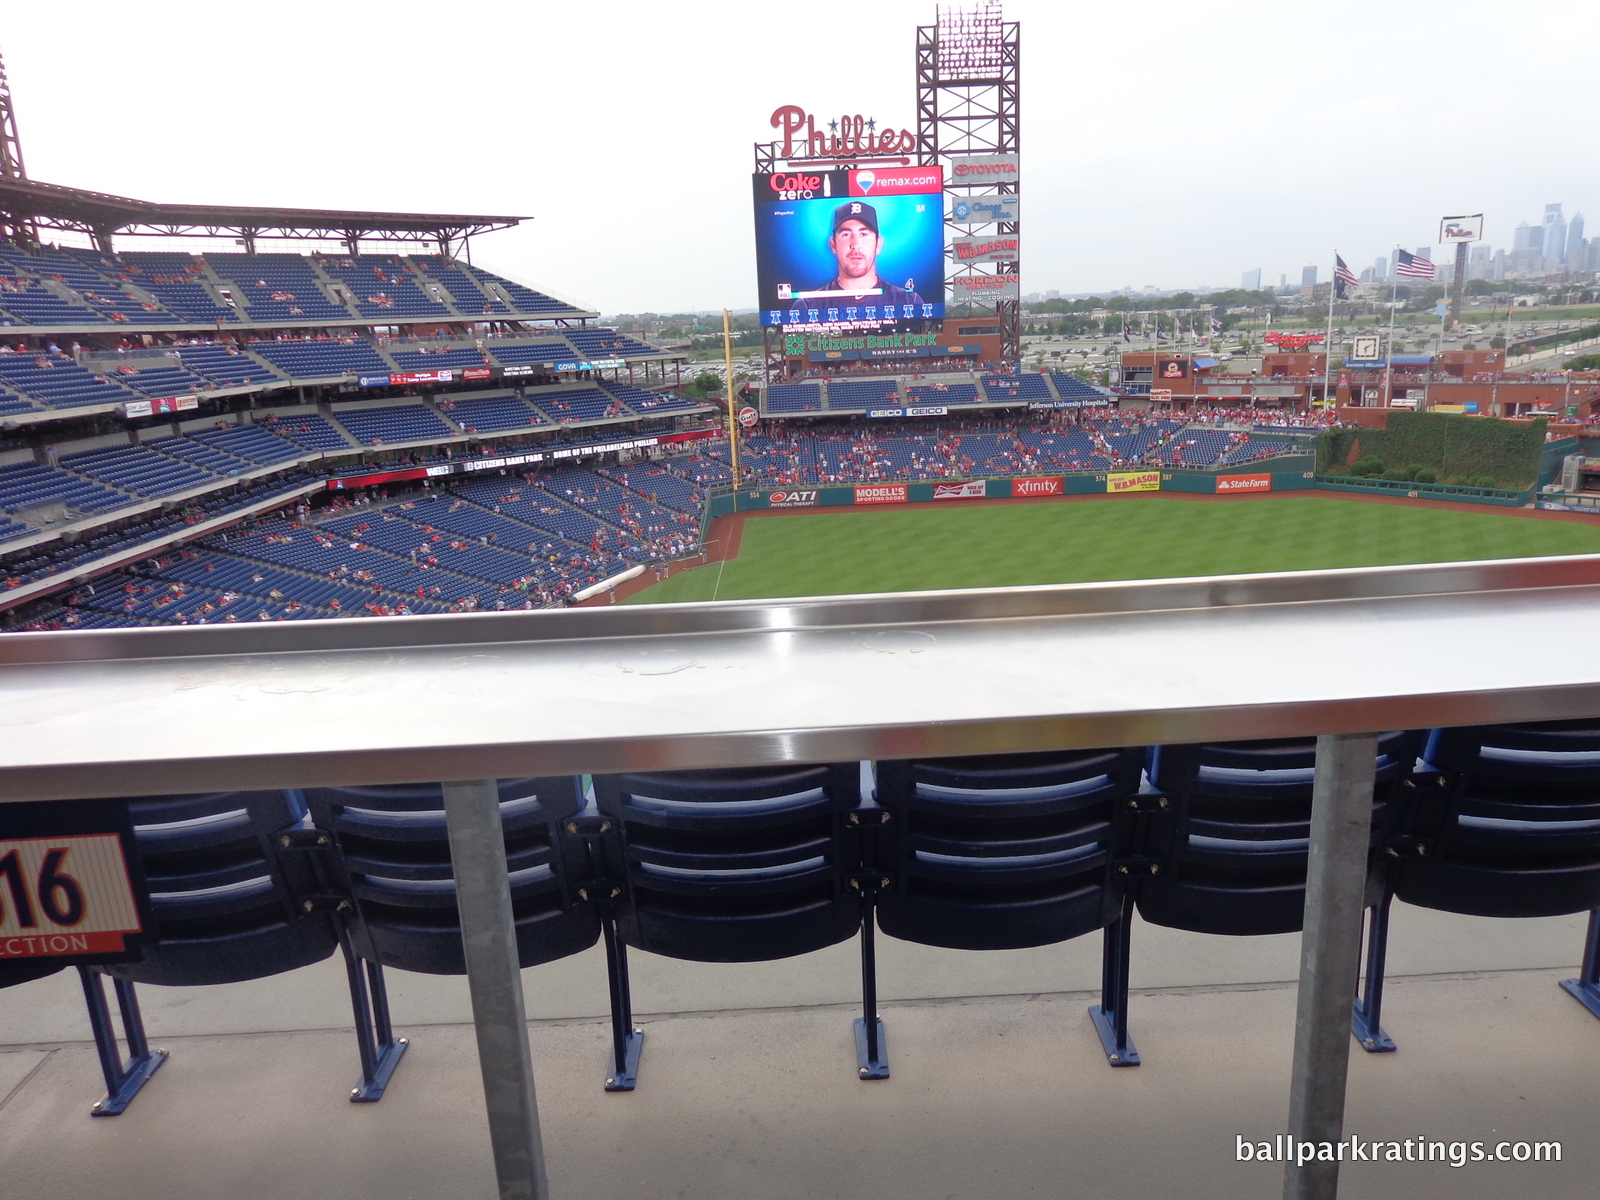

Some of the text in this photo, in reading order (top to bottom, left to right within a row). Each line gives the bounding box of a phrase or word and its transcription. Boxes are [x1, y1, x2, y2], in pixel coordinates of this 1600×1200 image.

[770, 105, 916, 158] Phillies
[970, 163, 1016, 174] TOYOTA
[770, 172, 821, 191] Coke
[876, 175, 937, 188] remax.com
[779, 189, 814, 201] zero
[954, 275, 1018, 285] HORIZON
[808, 331, 936, 351] Citizens Bank Park
[1030, 402, 1054, 410] Jefferson
[1082, 399, 1108, 407] Hospitals
[740, 412, 756, 422] Gulf
[554, 449, 572, 458] HOME
[580, 446, 592, 455] THE
[594, 441, 634, 453] PHILADELPHIA
[634, 438, 658, 448] PHILLIES
[474, 458, 506, 470] CITIZENS
[506, 456, 525, 466] BANK
[526, 454, 543, 462] PARK
[1018, 480, 1058, 494] xfinity
[1114, 474, 1158, 490] W.B.MASON
[786, 491, 816, 502] ATI
[856, 487, 905, 497] MODELL'S
[0, 847, 87, 929] 16
